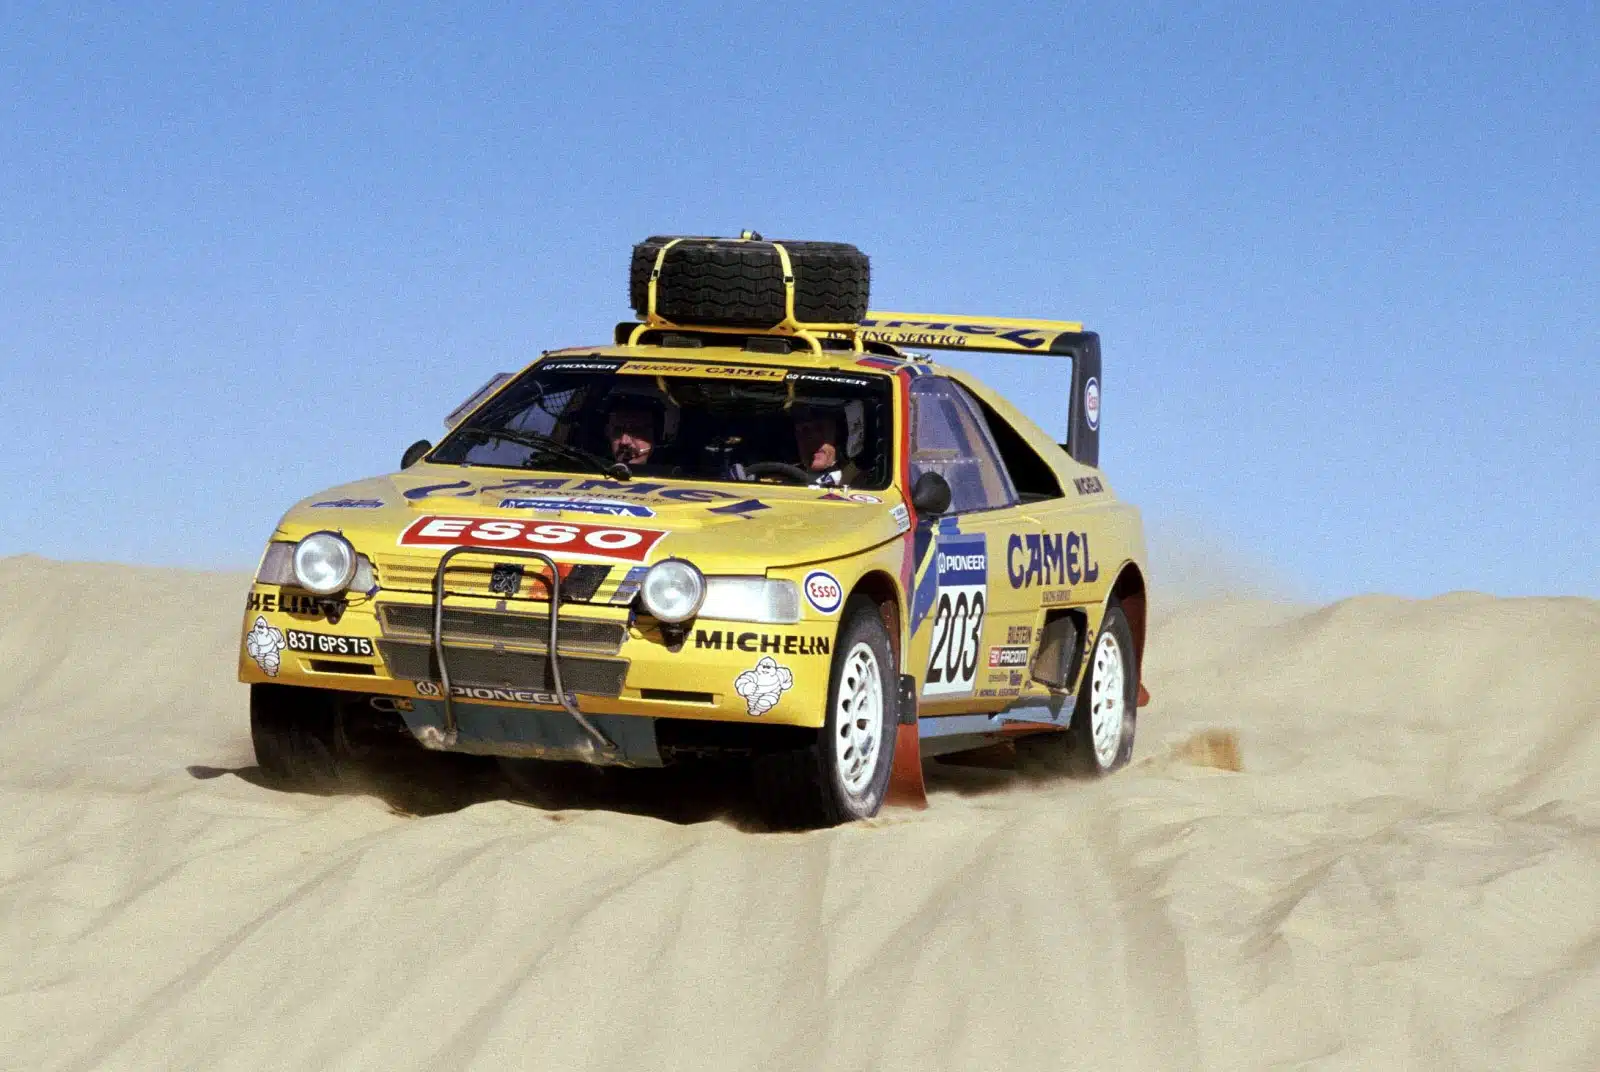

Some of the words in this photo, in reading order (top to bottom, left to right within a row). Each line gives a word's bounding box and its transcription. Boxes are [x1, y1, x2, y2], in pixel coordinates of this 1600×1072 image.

[896, 332, 967, 346] SERVICE
[556, 363, 617, 371] PIONEER
[624, 364, 697, 373] PEUGEOT
[705, 367, 784, 378] CAMEL
[800, 374, 870, 387] PIONEER
[1073, 476, 1104, 495] MICHELIN
[403, 478, 772, 519] CAMEL
[419, 519, 642, 549] ESSO
[946, 554, 986, 574] PIONEER
[1007, 531, 1099, 589] CAMEL
[288, 631, 314, 650] 837
[319, 636, 348, 654] GPS
[349, 638, 371, 654] 75
[695, 629, 829, 655] MICHELIN
[926, 590, 985, 683] 203
[1001, 649, 1027, 664] FACOM
